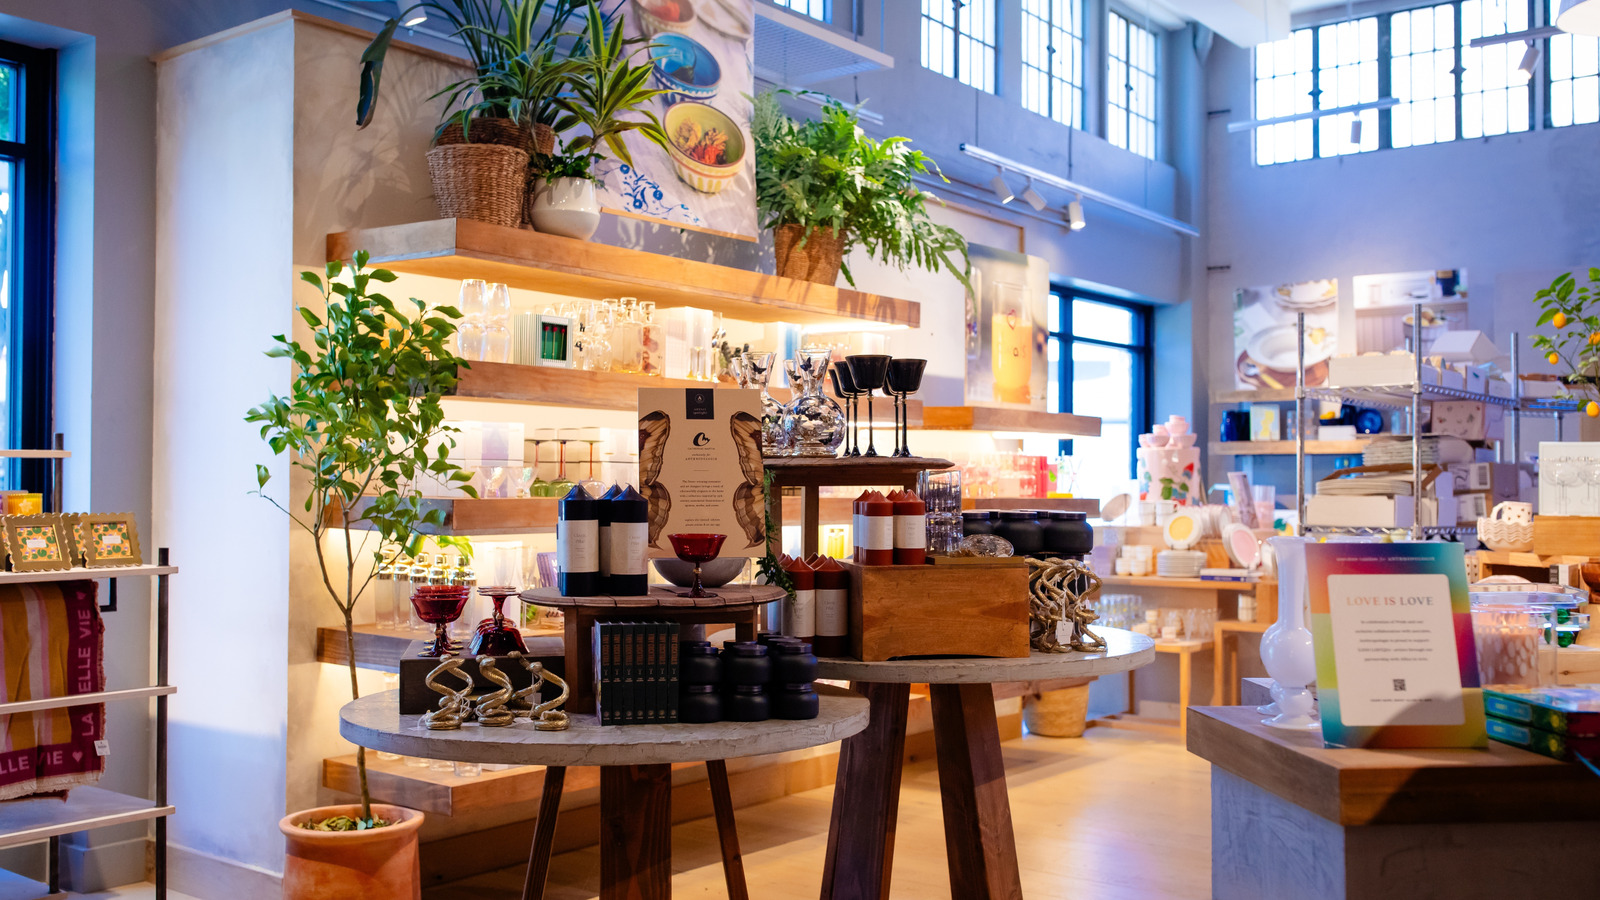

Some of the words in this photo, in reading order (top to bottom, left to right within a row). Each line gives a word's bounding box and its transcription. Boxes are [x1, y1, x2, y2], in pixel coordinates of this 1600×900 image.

[1345, 596, 1381, 606] LOVE
[1384, 596, 1396, 606] IS
[1400, 596, 1435, 606] LOVE
[78, 609, 91, 639] VIE
[78, 646, 91, 693] ELLE
[82, 712, 94, 737] LA
[0, 755, 30, 775] LLE
